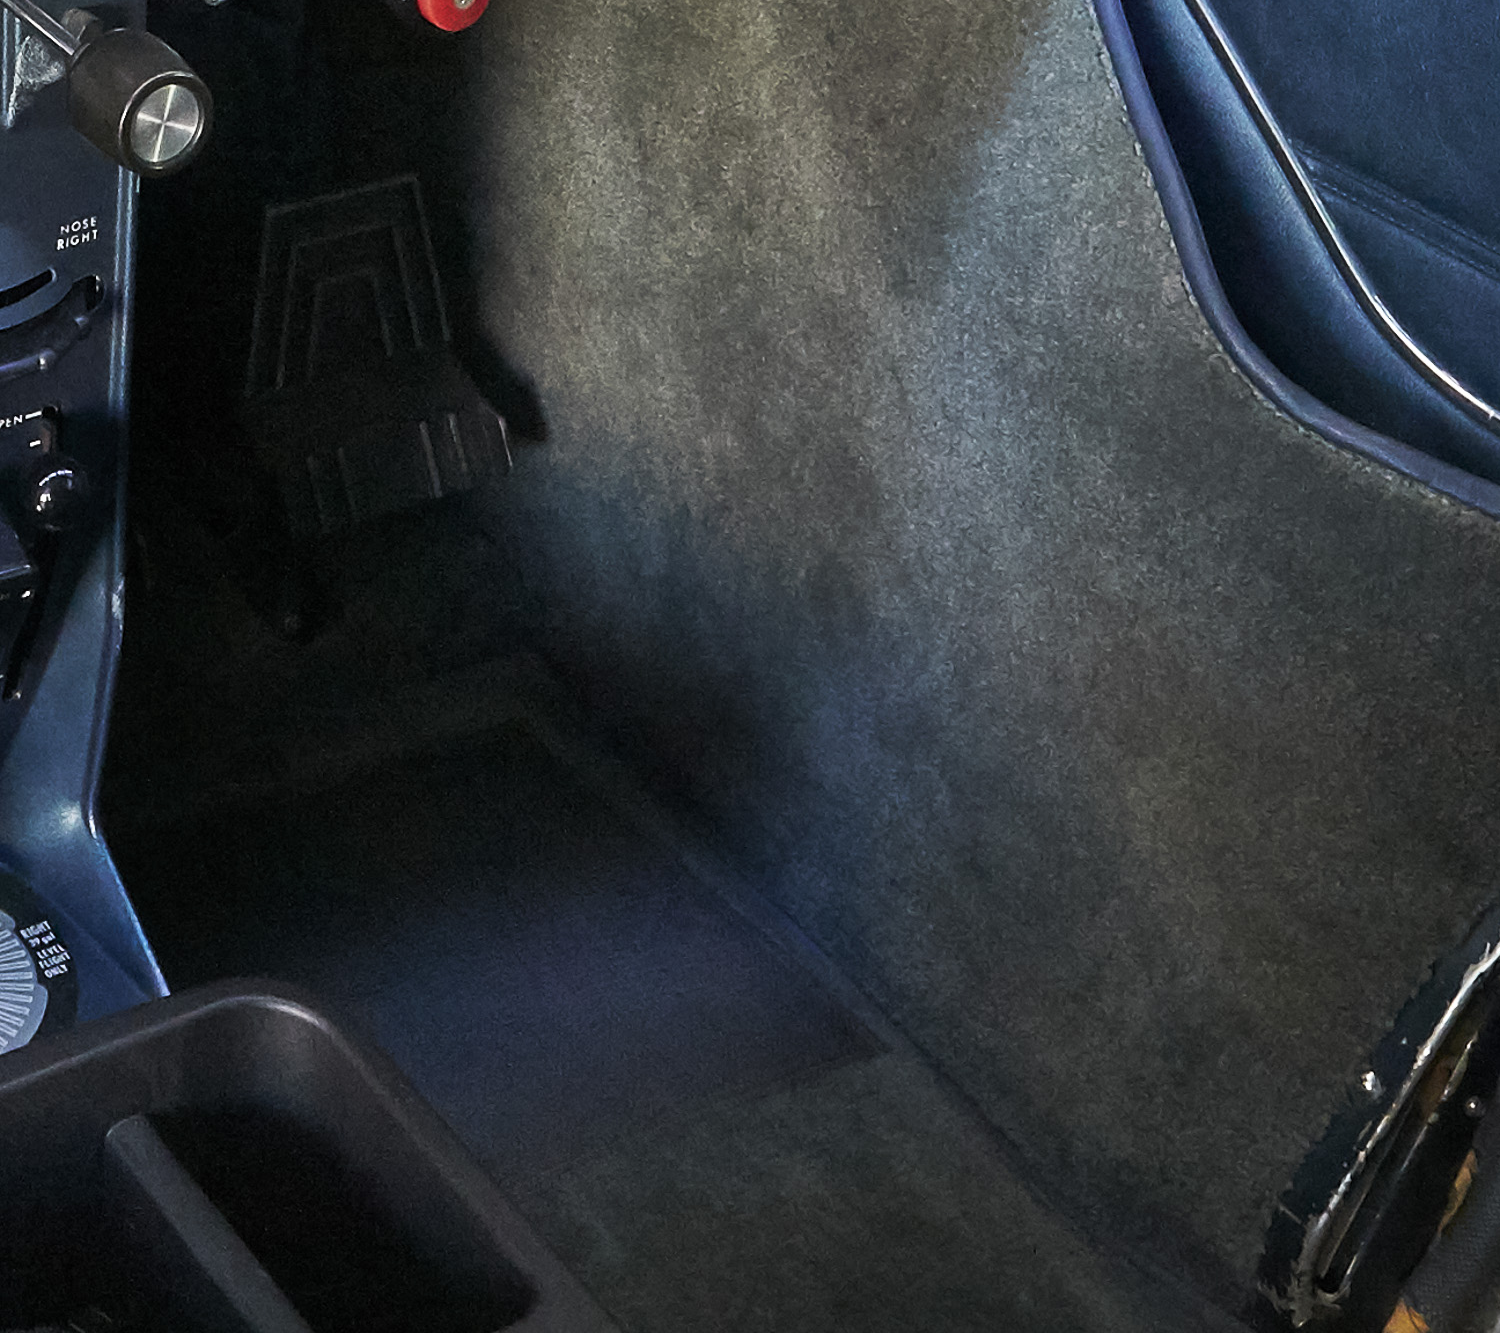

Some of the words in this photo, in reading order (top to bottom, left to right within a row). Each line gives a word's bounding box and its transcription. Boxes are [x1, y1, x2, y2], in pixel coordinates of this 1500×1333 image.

[60, 217, 98, 235] NOSE
[56, 230, 100, 250] RIGHT
[19, 920, 52, 938] RIGHT
[38, 952, 71, 971] FLIGHT
